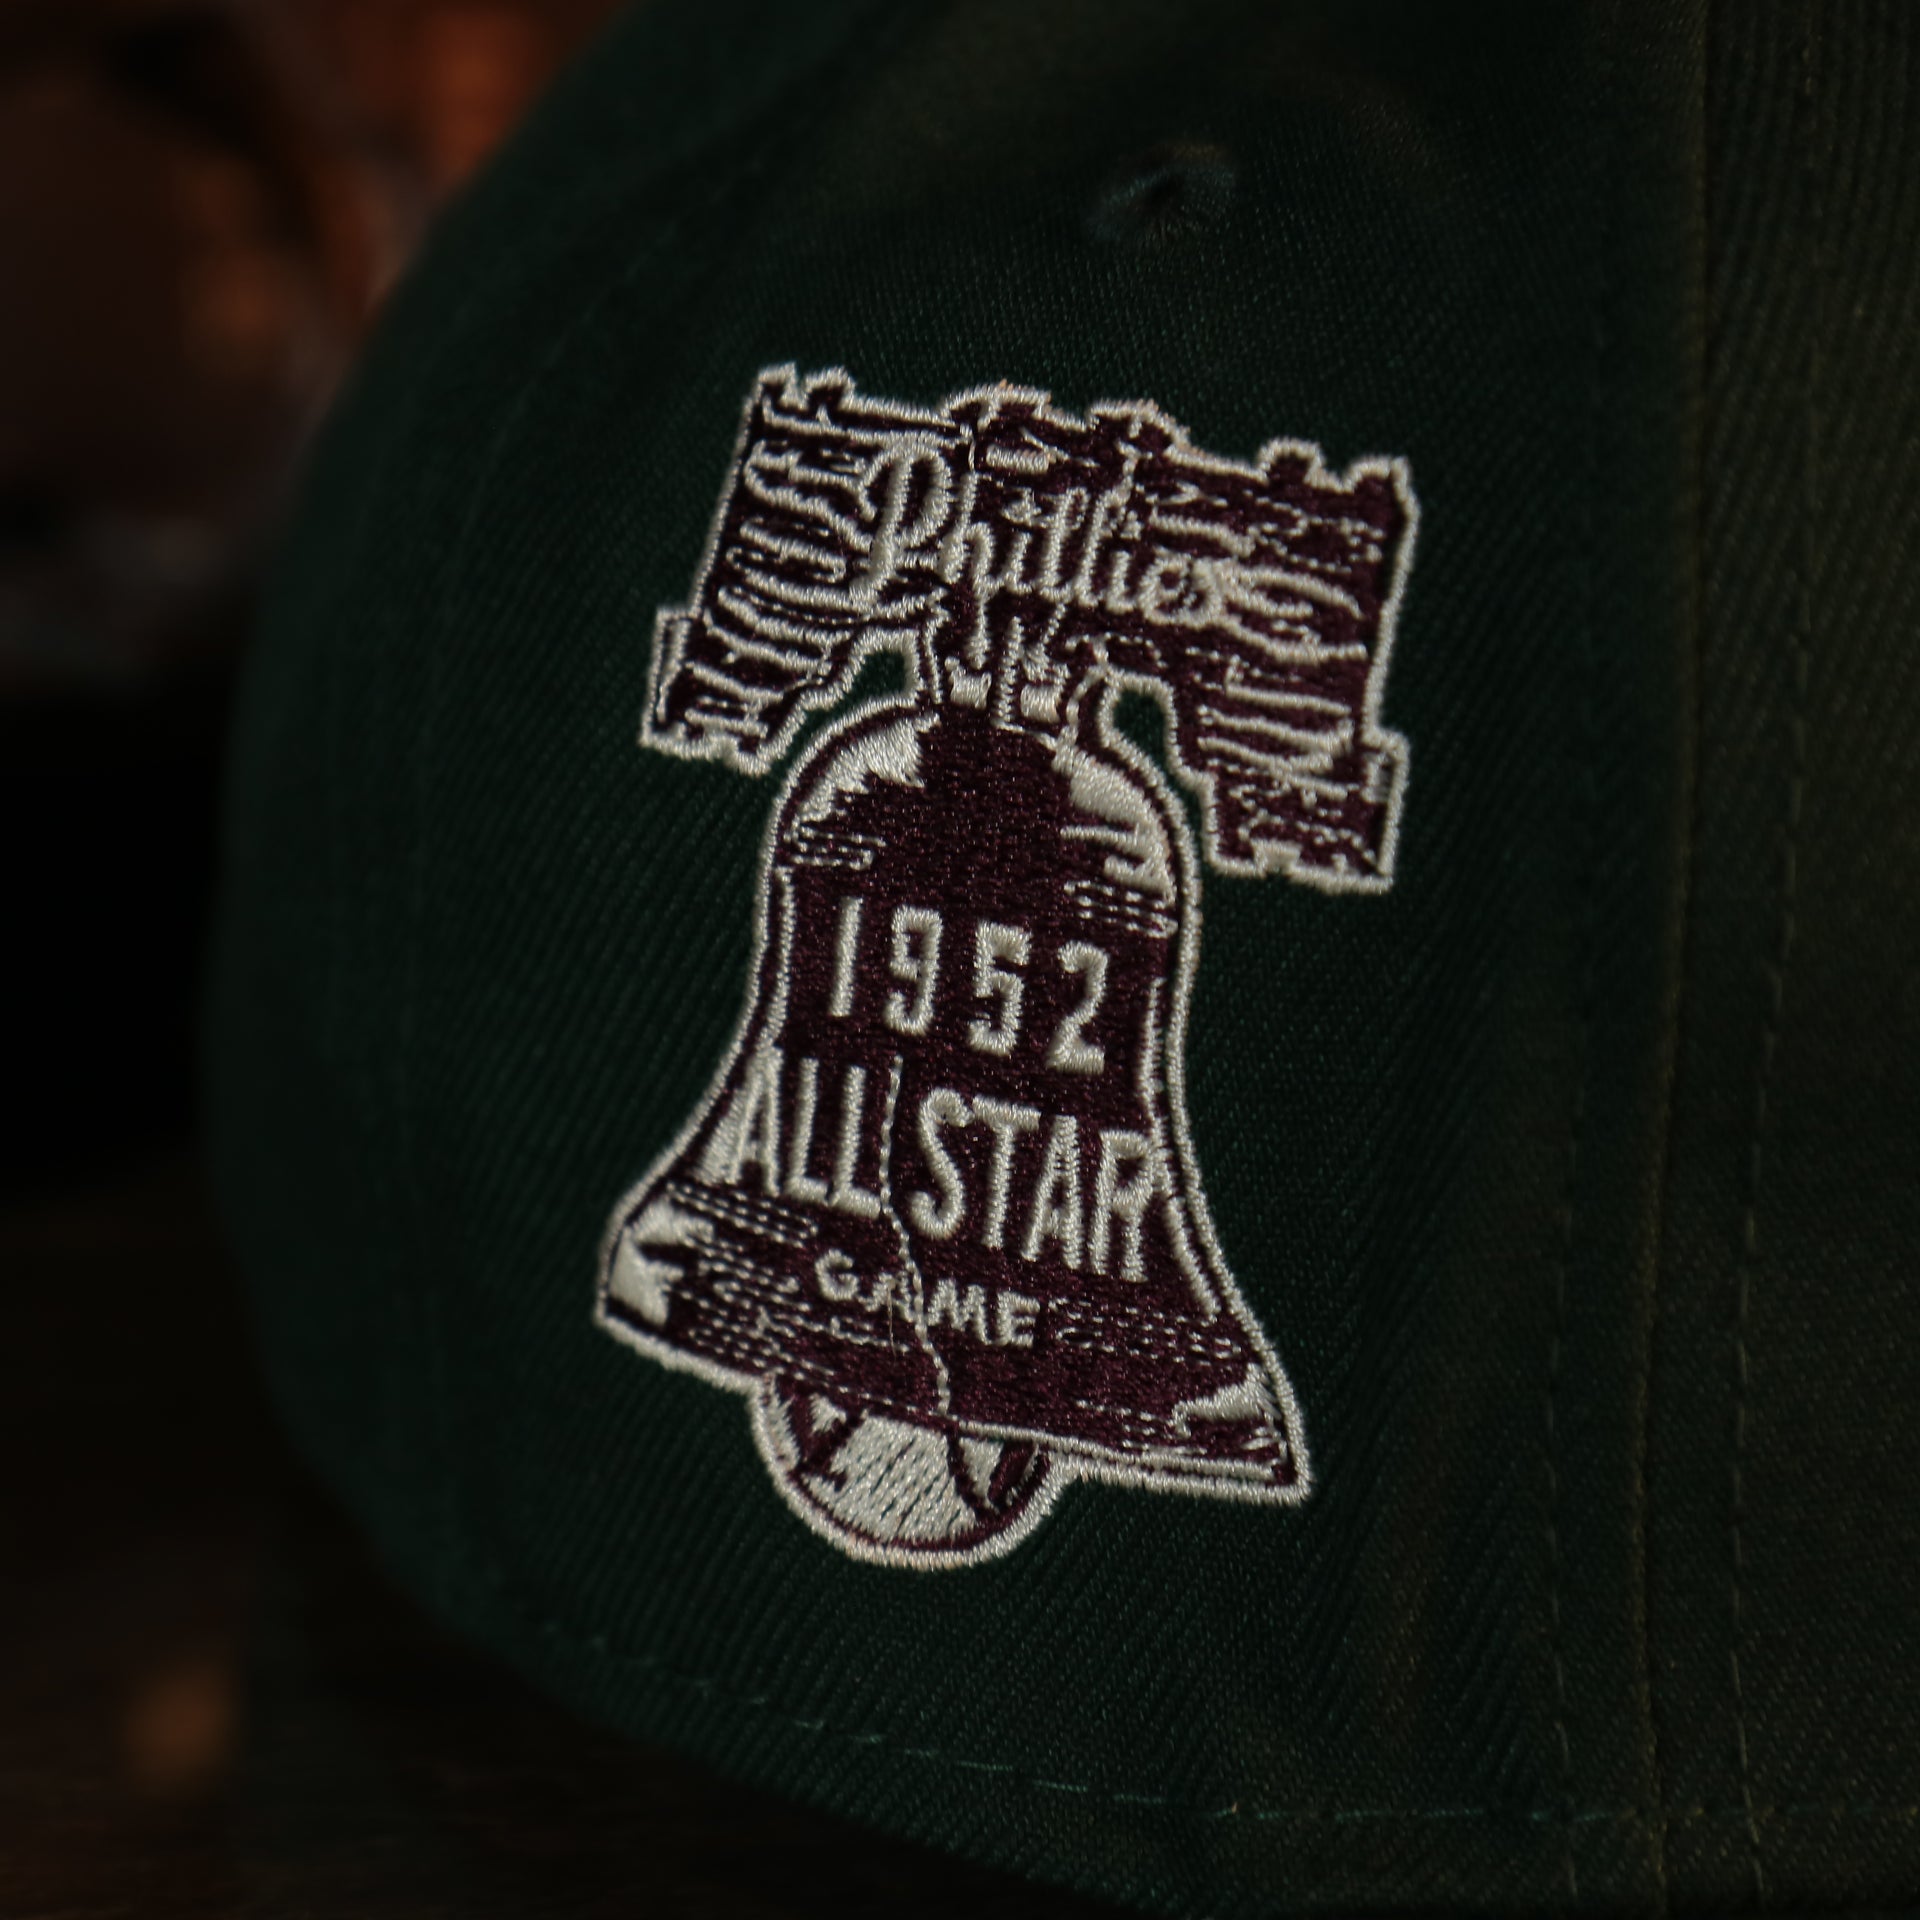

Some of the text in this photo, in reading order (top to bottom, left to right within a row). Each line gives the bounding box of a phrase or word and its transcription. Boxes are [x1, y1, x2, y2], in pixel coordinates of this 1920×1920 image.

[849, 430, 1222, 624] Phillies
[828, 898, 1108, 1074] 1952
[727, 1046, 1154, 1284] ALL STAR
[814, 1249, 1040, 1348] GAME
